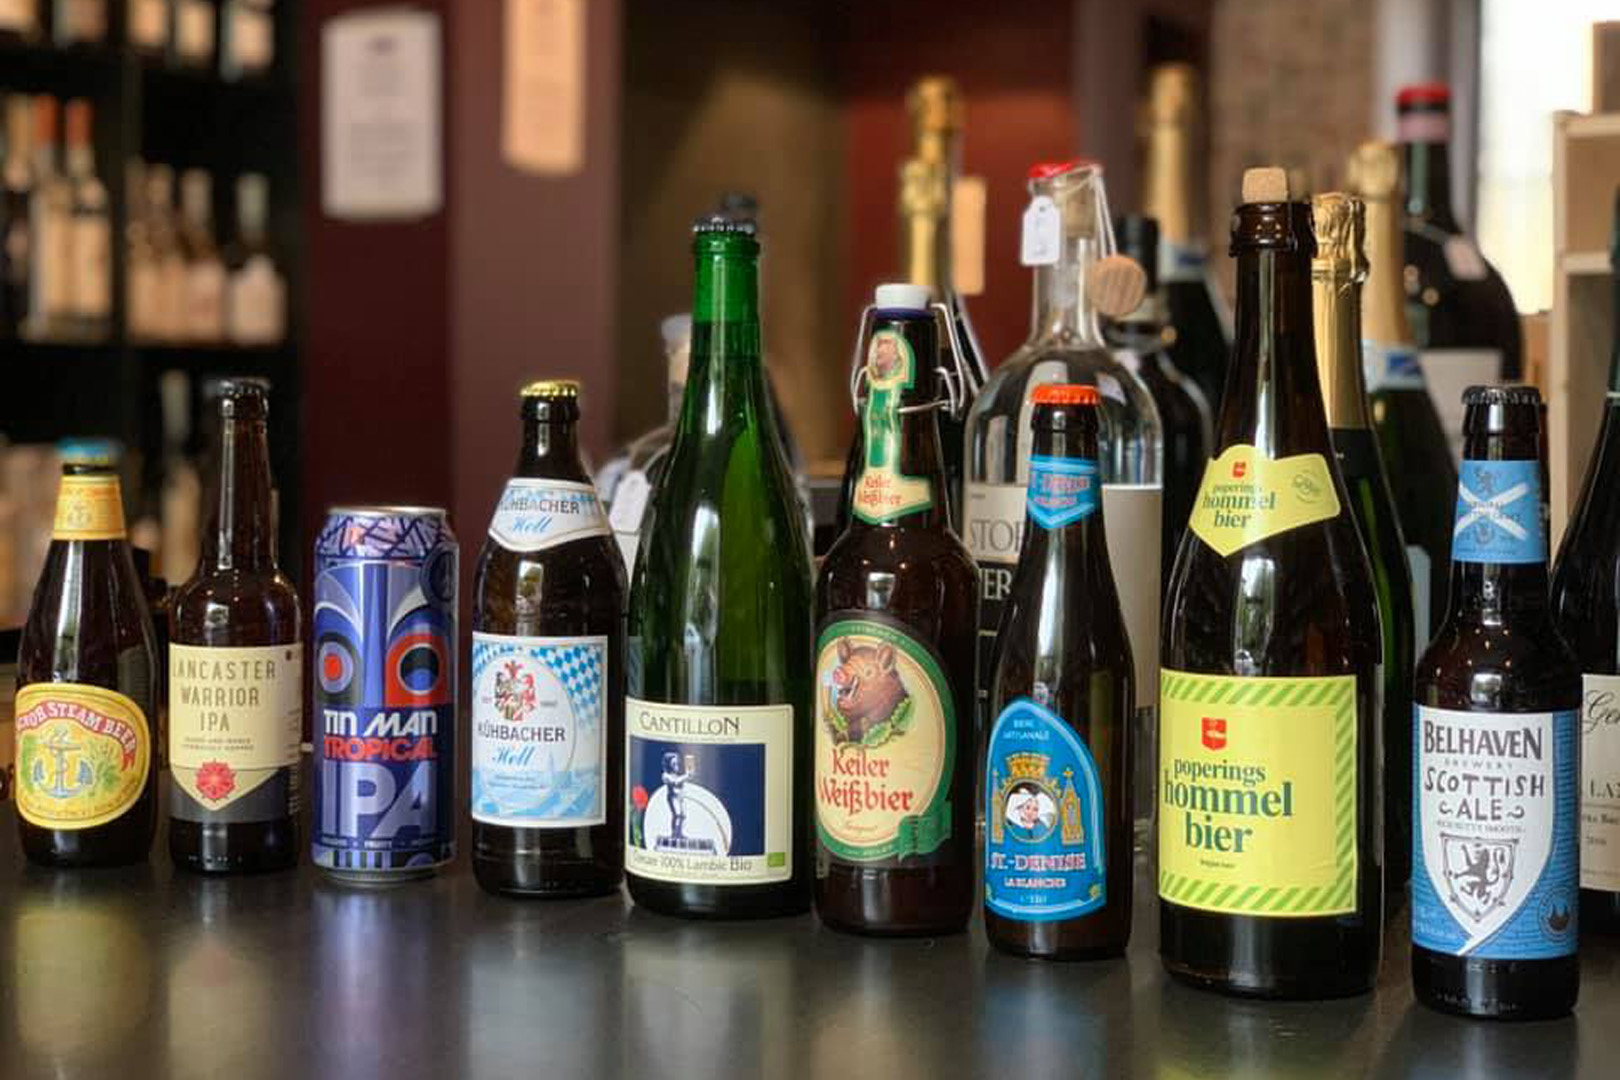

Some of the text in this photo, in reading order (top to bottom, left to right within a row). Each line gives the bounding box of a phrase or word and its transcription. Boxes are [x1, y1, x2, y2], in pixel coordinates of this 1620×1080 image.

[1202, 491, 1275, 509] hommel
[1214, 510, 1252, 527] bier
[172, 660, 277, 681] LANCASTER
[180, 686, 260, 707] WARRIOR
[47, 701, 102, 734] STEAM
[105, 718, 137, 752] BEER
[200, 711, 231, 732] IPA
[323, 709, 358, 735] TIN
[362, 710, 438, 737] MAN
[639, 711, 741, 736] CANTILLON
[323, 736, 437, 760] TROPICAL
[1423, 720, 1543, 761] BELHAVEN
[491, 746, 535, 767] Hell
[832, 748, 891, 779] Keiler
[1174, 758, 1267, 787] poperings
[1424, 766, 1545, 798] SCOTTISH
[323, 759, 438, 840] IPA
[819, 776, 915, 814] Weißbier
[1163, 768, 1293, 818] hommel
[1456, 798, 1502, 821] ALE
[1185, 811, 1253, 854] bier
[687, 858, 728, 872] Lambic
[729, 856, 753, 872] Bio
